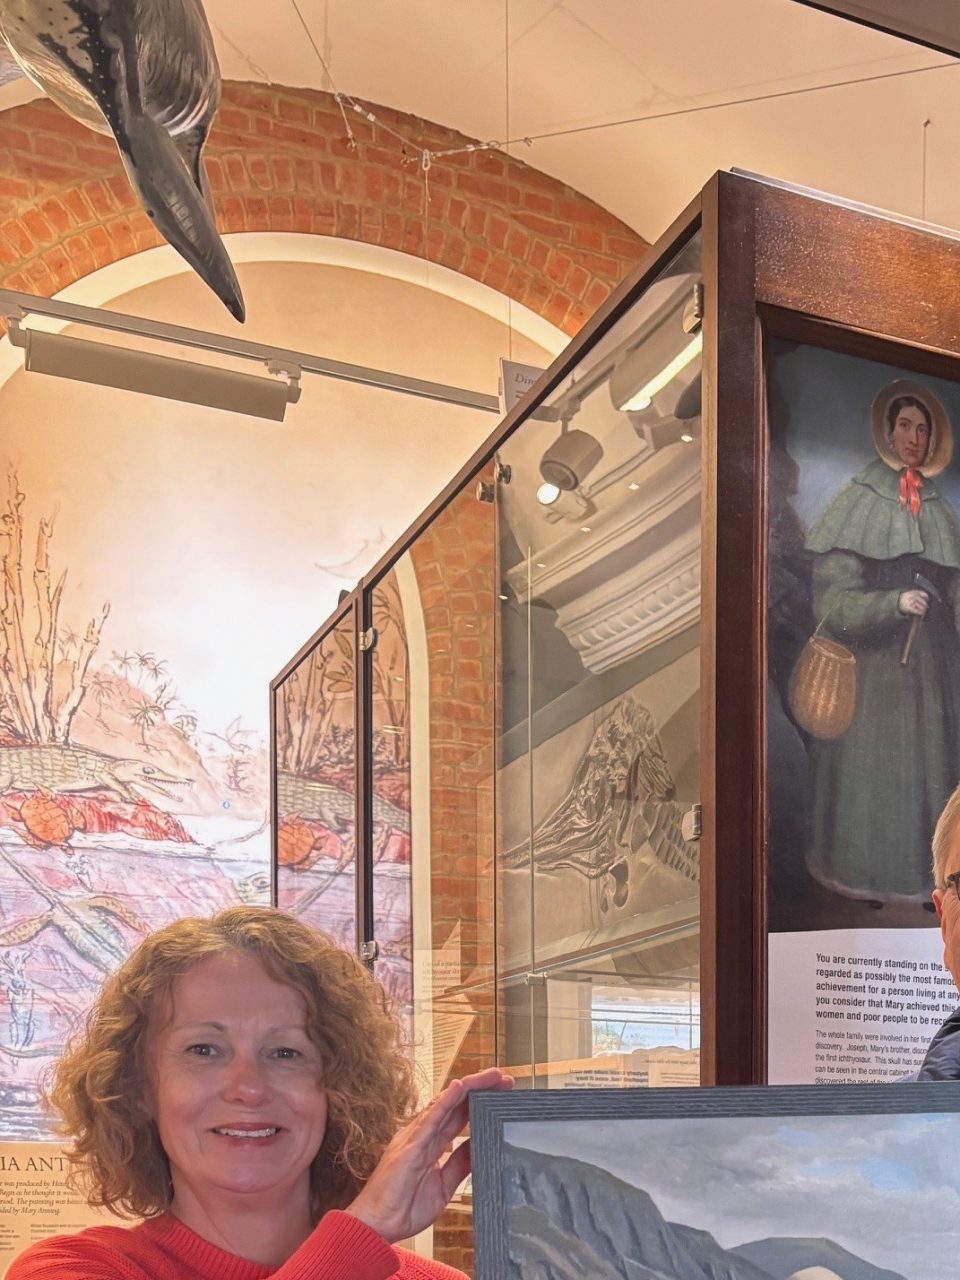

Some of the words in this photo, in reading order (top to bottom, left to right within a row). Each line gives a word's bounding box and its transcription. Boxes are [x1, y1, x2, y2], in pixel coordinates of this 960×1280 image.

[816, 952, 831, 963] You
[832, 956, 846, 964] are
[847, 957, 883, 968] currently
[884, 959, 918, 971] standing
[930, 962, 943, 972] the
[816, 968, 852, 979] regarded
[853, 971, 863, 979] as
[864, 972, 897, 983] possibly
[898, 973, 911, 983] the
[912, 975, 932, 984] most
[816, 981, 866, 994] achievement
[868, 984, 879, 994] for
[880, 987, 887, 995] a
[887, 988, 914, 997] person
[916, 987, 937, 1000] living
[938, 990, 946, 999] at
[947, 991, 960, 1002] any
[816, 996, 830, 1006] you
[832, 997, 866, 1007] consider
[867, 998, 883, 1009] that
[885, 999, 905, 1012] Mary
[906, 1001, 940, 1012] achieved
[941, 1003, 956, 1013] this
[816, 1010, 845, 1019] women
[846, 1011, 862, 1021] and
[863, 1013, 881, 1023] poor
[882, 1014, 909, 1025] people
[910, 1015, 918, 1024] to
[919, 1015, 930, 1025] be
[816, 1030, 827, 1038] The
[846, 1032, 863, 1041] family
[879, 1034, 903, 1042] involved
[920, 1036, 932, 1044] first
[815, 1042, 843, 1051] discovery.
[869, 1044, 889, 1053] Mary's
[825, 1054, 838, 1062] first
[838, 1055, 871, 1064] ichthyosaur.
[874, 1056, 888, 1064] This
[902, 1058, 913, 1066] has
[827, 1066, 836, 1074] be
[858, 1067, 868, 1075] the
